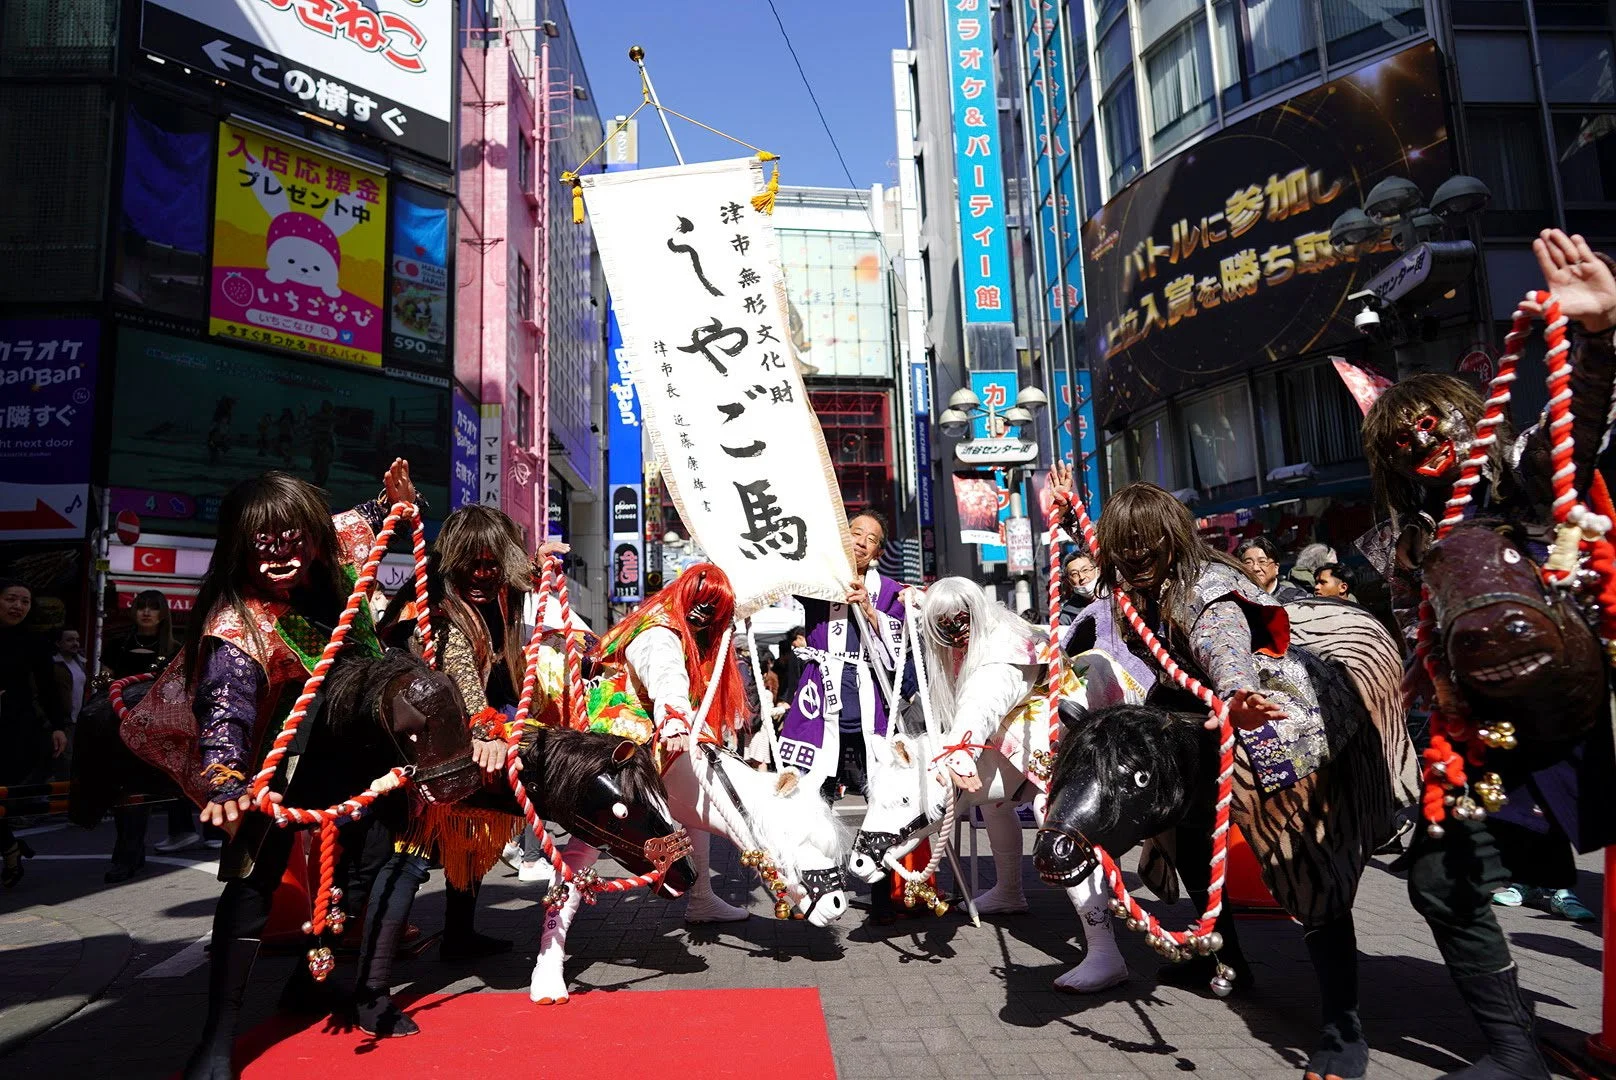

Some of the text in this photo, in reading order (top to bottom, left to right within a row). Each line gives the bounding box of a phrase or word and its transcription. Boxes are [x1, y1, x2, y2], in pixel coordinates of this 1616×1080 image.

[262, 0, 425, 72] きねこ
[251, 53, 407, 137] この横すぐ
[228, 132, 381, 206] 入店応援金
[237, 168, 371, 225] プレゼント中
[256, 287, 374, 327] いちごなび
[258, 313, 314, 333] いちごなび
[719, 201, 794, 406] 津市無形文化財
[1104, 228, 1394, 360] 上位入賞を勝ち取
[393, 335, 427, 353] 590
[653, 340, 681, 399] 津市長
[15, 439, 43, 449] next
[44, 437, 74, 449] door
[615, 587, 638, 597] B1F
